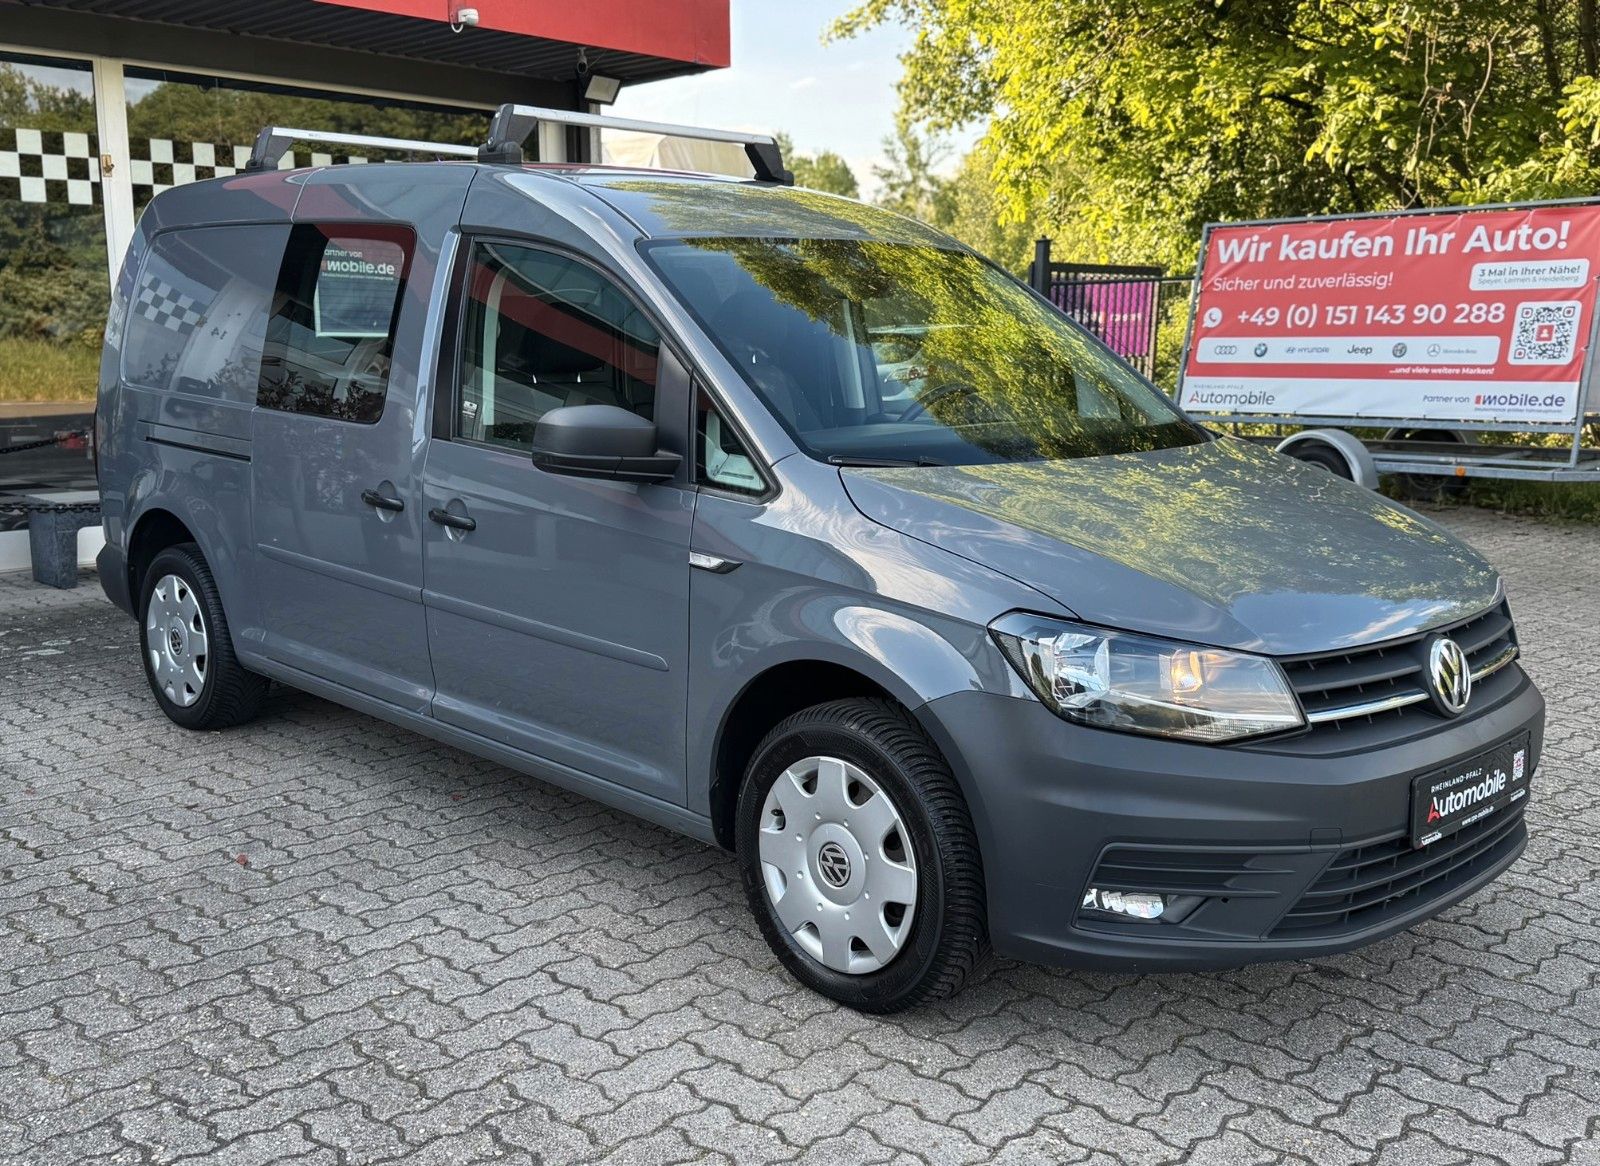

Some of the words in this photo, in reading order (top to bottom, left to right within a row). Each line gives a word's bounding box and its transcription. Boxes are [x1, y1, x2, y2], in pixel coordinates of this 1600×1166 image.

[1218, 235, 1272, 263] Wir
[1278, 231, 1394, 261] kaufen
[1404, 227, 1456, 255] Ihr
[1462, 220, 1570, 253] Auto!
[324, 249, 347, 257] artner
[349, 250, 363, 258] von
[327, 260, 395, 275] mobile.de
[1479, 269, 1486, 277] 3
[1488, 268, 1507, 277] Mal
[1508, 267, 1519, 276] in
[1521, 266, 1546, 275] Ihrer
[1549, 265, 1581, 275] Nähe!
[1212, 276, 1260, 291] Sicher
[1263, 275, 1296, 290] und
[1297, 272, 1394, 291] zuverlässig!
[1238, 306, 1280, 326] +49
[1286, 303, 1318, 329] (0)
[1325, 305, 1358, 325] 151
[1364, 304, 1406, 325] 143
[1412, 303, 1447, 324] 90
[1453, 302, 1506, 323] 288
[1347, 344, 1373, 356] Jeep
[1411, 366, 1429, 375] viele
[1431, 367, 1460, 375] weitere
[1188, 390, 1275, 405] Automobile
[1422, 394, 1452, 403] Partner
[1482, 393, 1566, 407] mobile.de
[1431, 767, 1482, 793] RHEINLAND-PFALZ
[1427, 769, 1506, 823] Automobile
